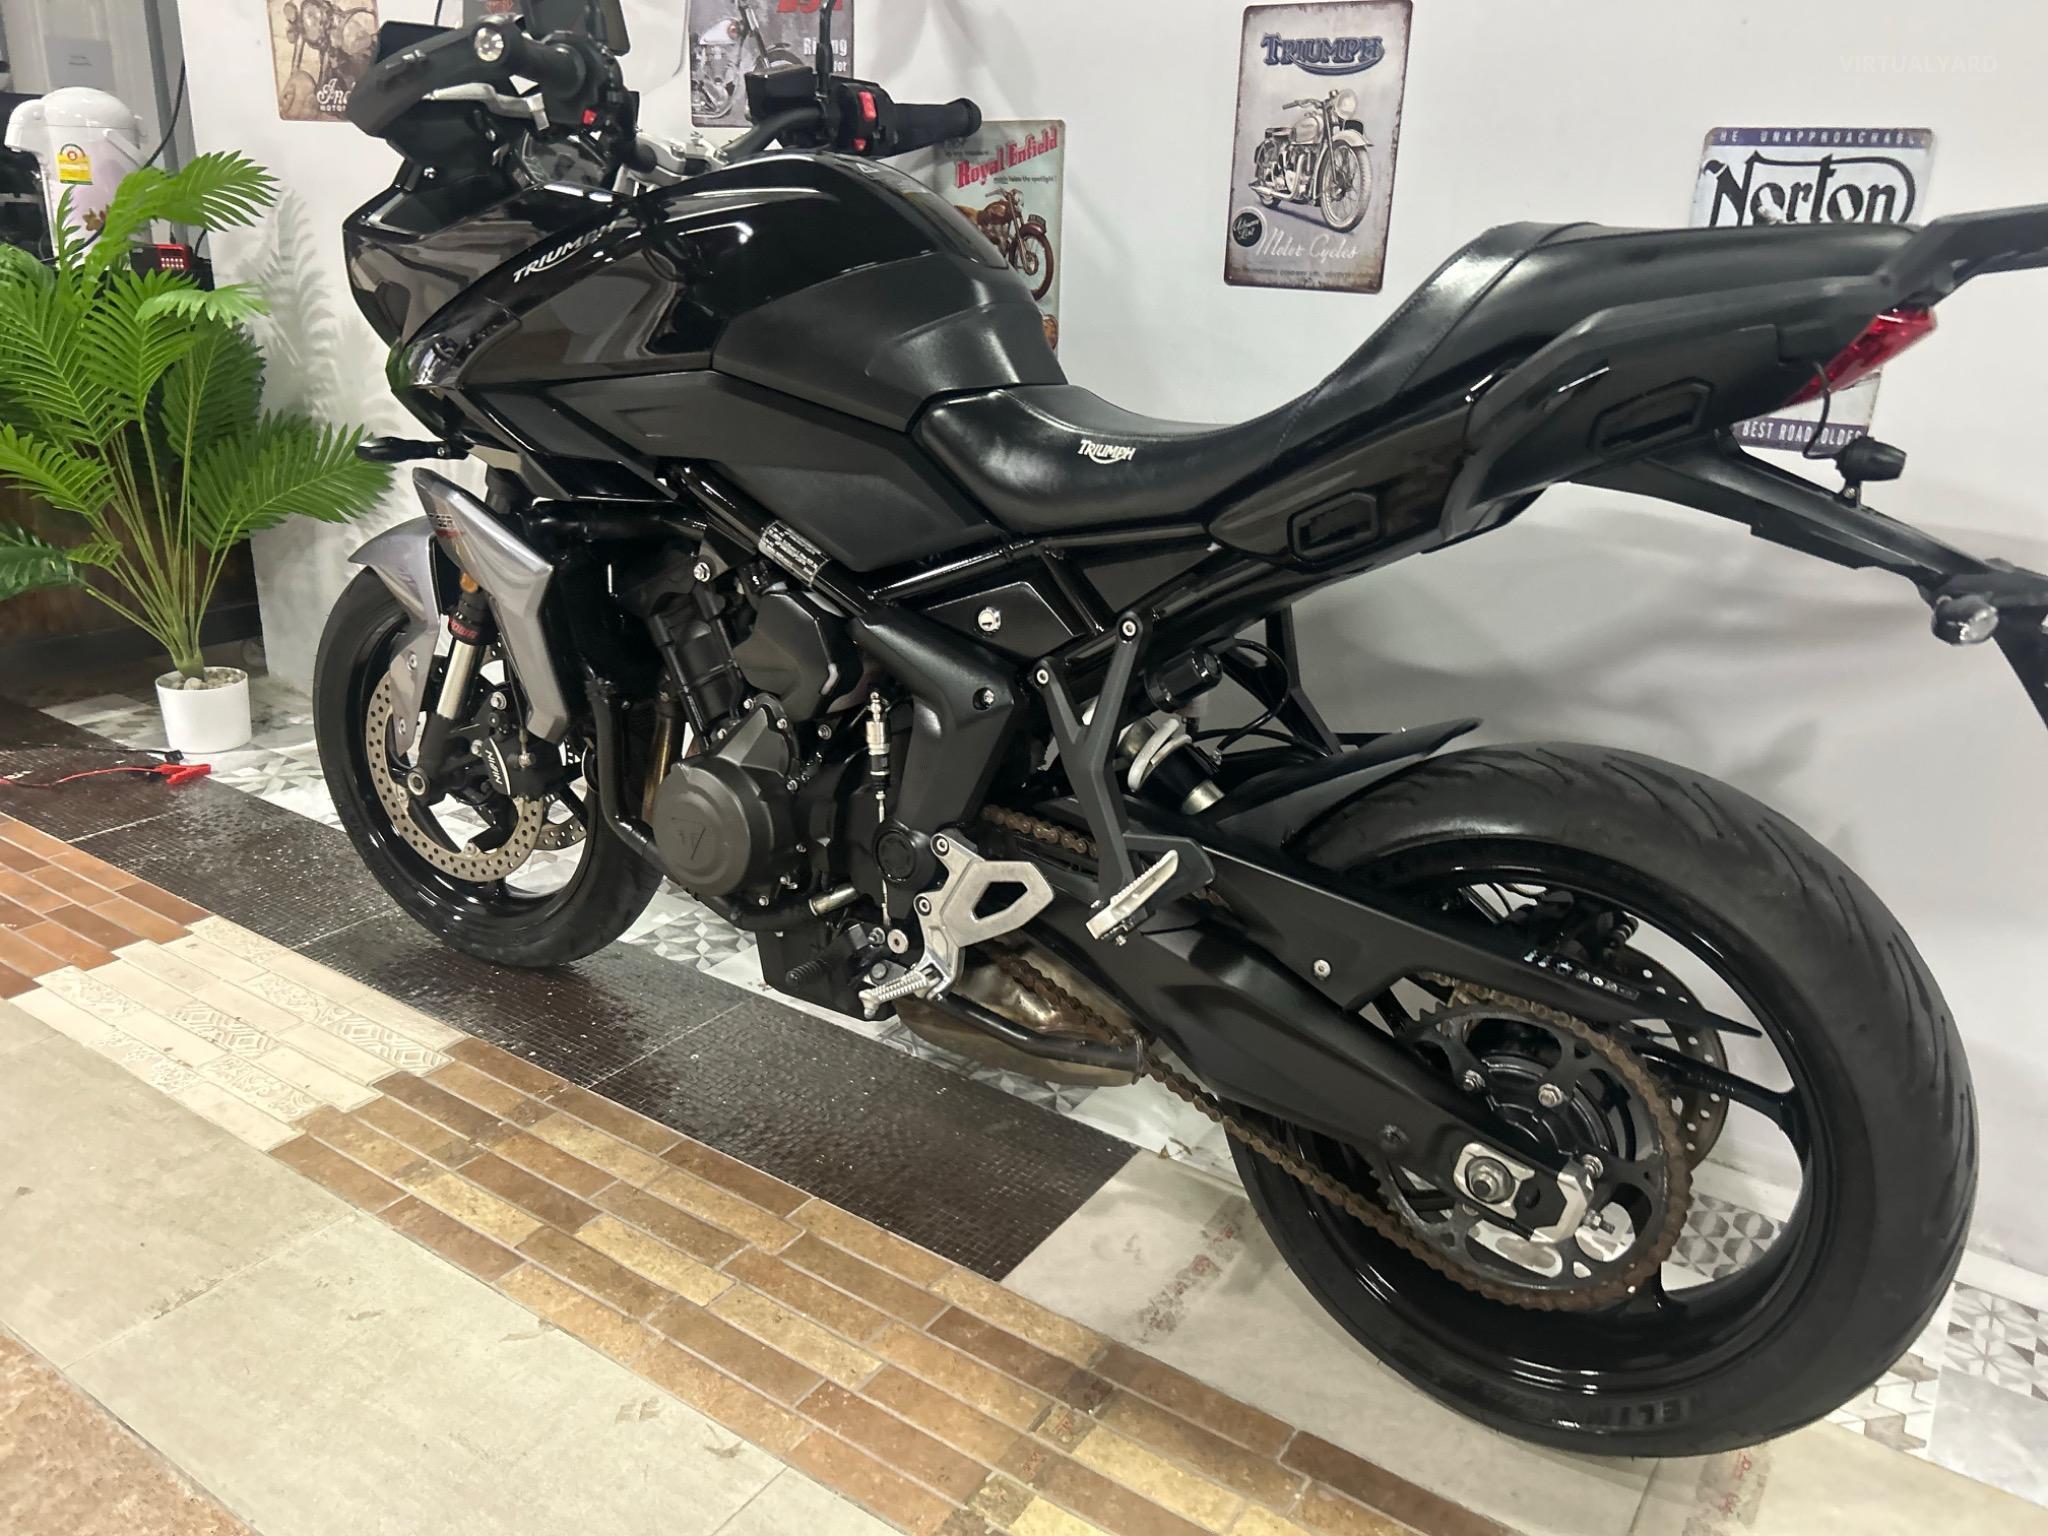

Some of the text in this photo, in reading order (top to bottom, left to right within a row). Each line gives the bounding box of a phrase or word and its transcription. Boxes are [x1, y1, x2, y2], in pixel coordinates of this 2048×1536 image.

[803, 37, 848, 56] Ring
[1260, 32, 1385, 76] TRIUMPH
[955, 125, 1058, 189] Royal Enfield
[1703, 150, 1916, 227] Norton
[513, 220, 617, 283] TRIUMPH
[1256, 227, 1361, 264] Motor Cycles
[1077, 438, 1137, 465] TRIUMPH
[1742, 421, 1864, 447] BEST ROADOLDE
